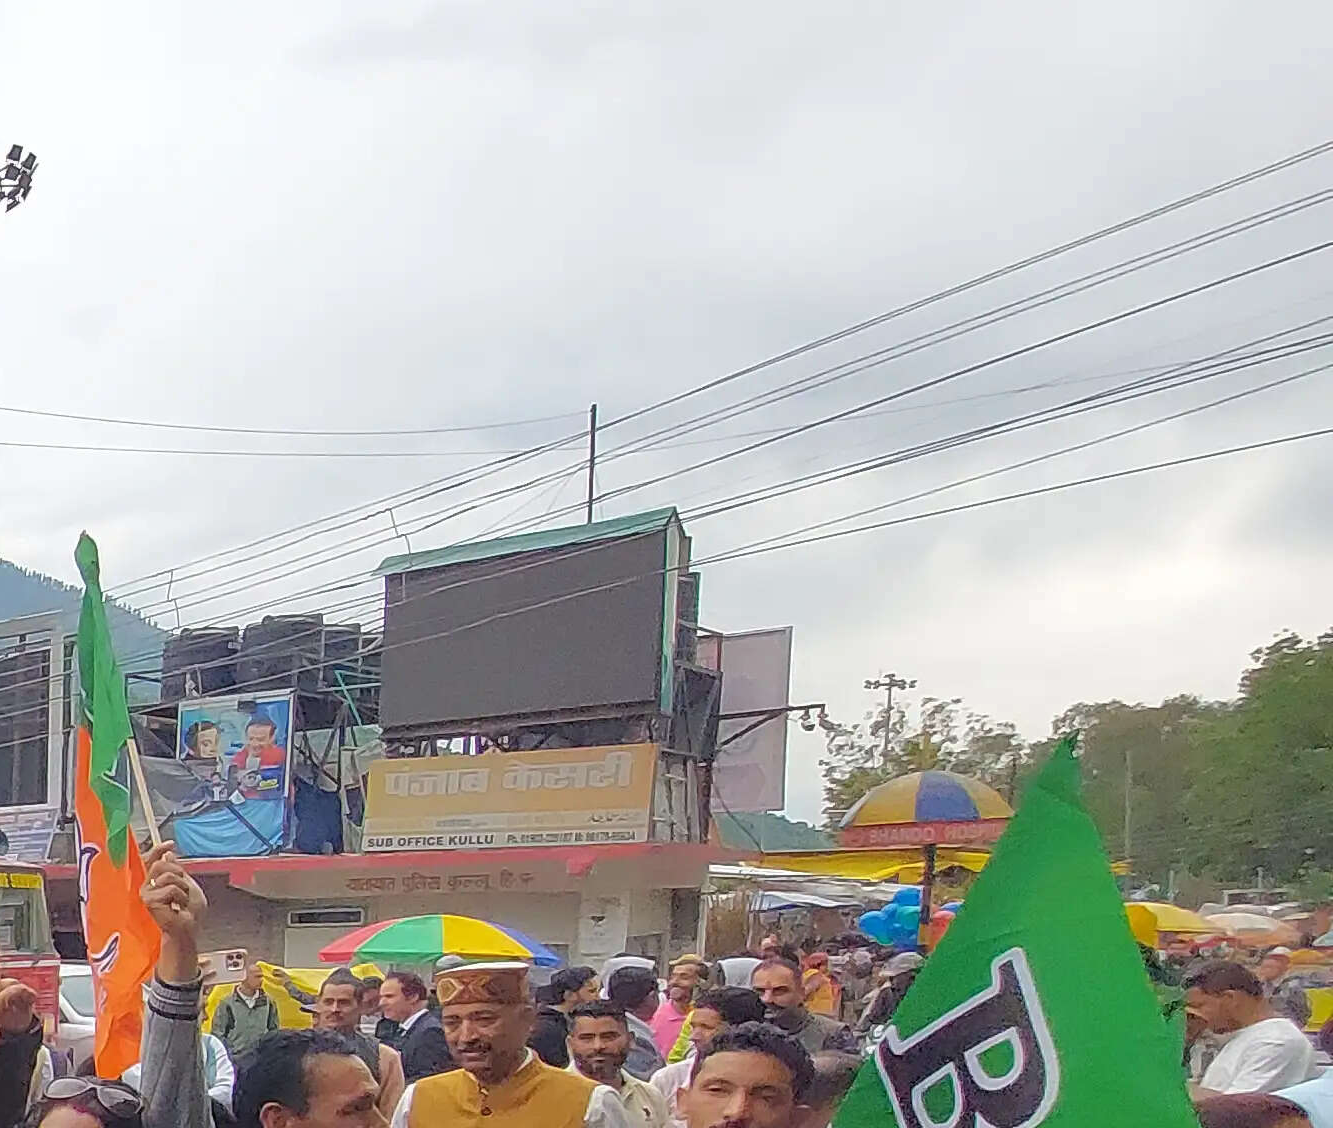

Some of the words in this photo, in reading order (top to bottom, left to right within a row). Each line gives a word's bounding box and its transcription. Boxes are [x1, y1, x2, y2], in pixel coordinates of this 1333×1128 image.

[367, 837, 393, 848] SUB
[397, 835, 444, 847] OFFICE
[448, 834, 494, 846] KULLU
